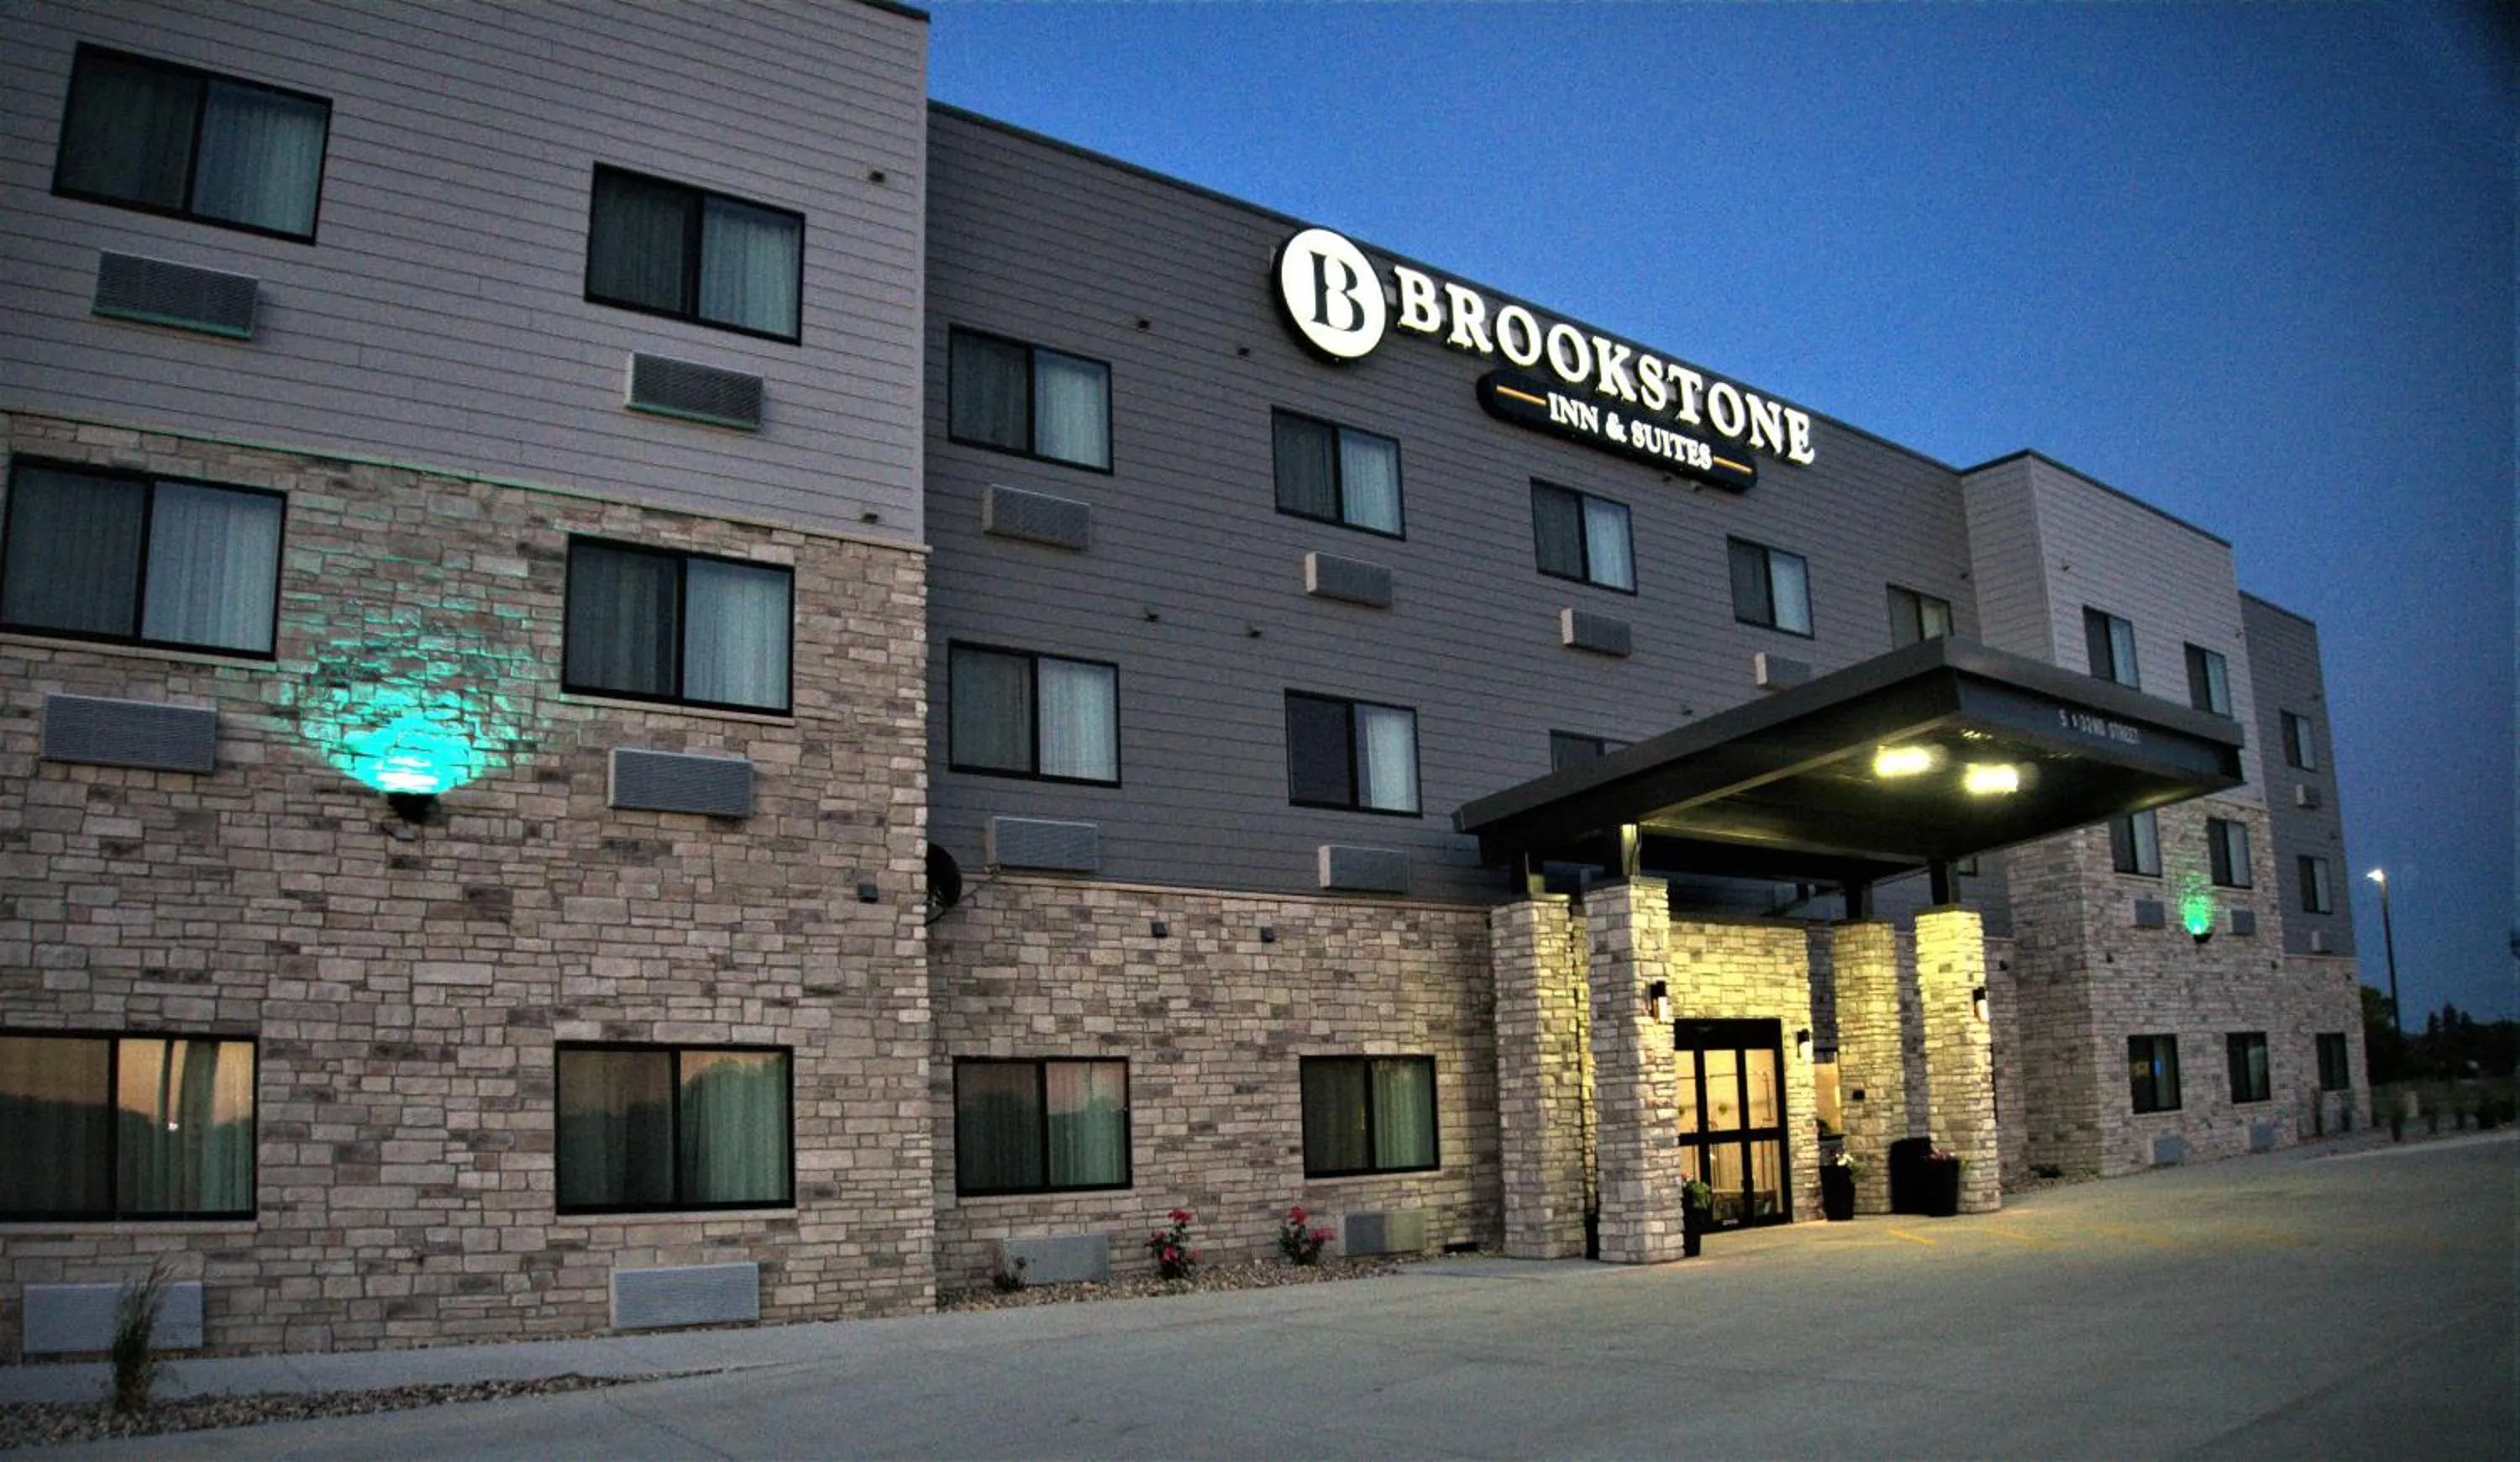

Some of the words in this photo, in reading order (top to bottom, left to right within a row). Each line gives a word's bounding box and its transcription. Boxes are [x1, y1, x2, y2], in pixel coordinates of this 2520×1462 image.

[1309, 250, 1366, 333] B
[1393, 265, 1815, 465] BROOKSTONE
[1546, 392, 1599, 435] INN
[1605, 413, 1628, 444] &
[1631, 418, 1713, 471] SUITES
